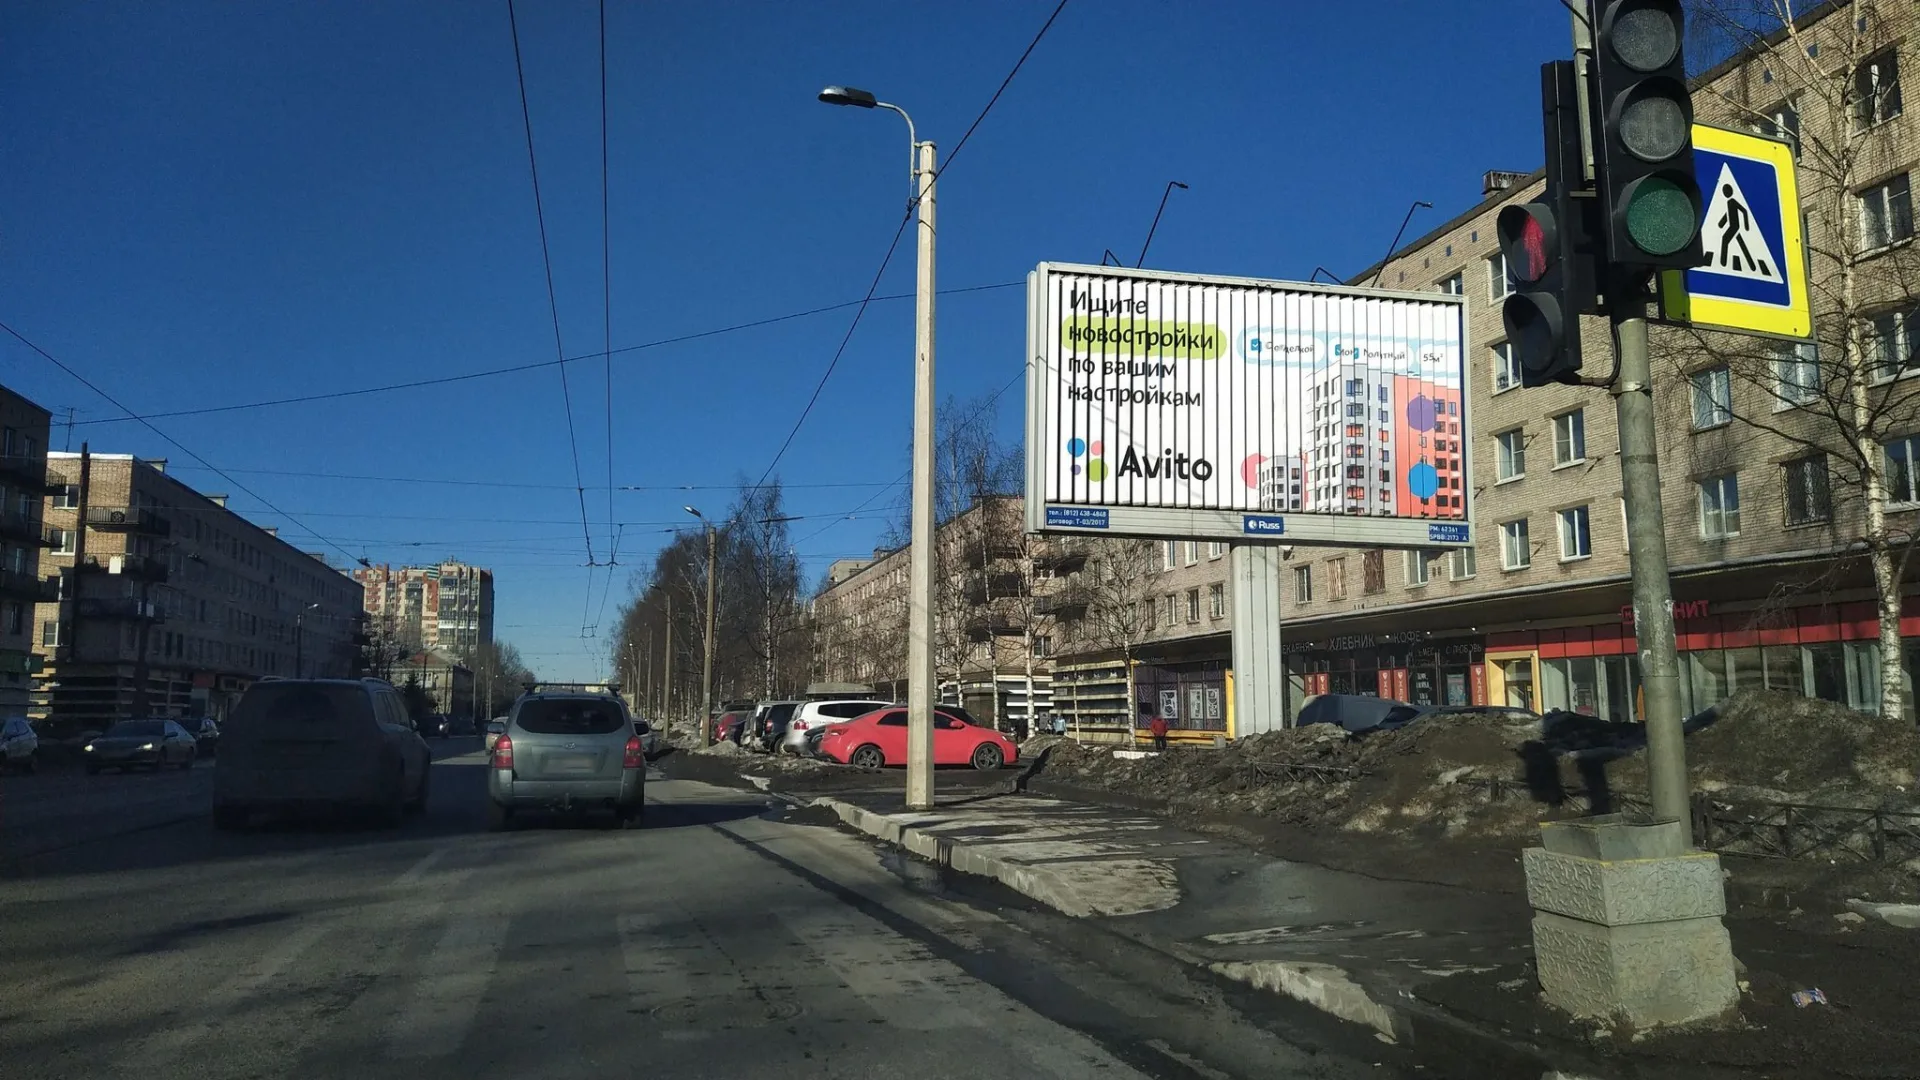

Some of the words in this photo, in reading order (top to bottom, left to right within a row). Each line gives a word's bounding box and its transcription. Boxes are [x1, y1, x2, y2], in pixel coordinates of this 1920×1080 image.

[1070, 290, 1147, 317] Ищите
[1069, 327, 1213, 350] новостройки
[1069, 358, 1095, 375] по
[1103, 361, 1177, 378] вашим
[1068, 386, 1201, 407] настройкам
[1118, 445, 1213, 481] Avito
[1259, 520, 1280, 530] Russ
[1282, 641, 1311, 655] ЕКАРНЯ
[1329, 634, 1375, 651] ХЛЕБНИК
